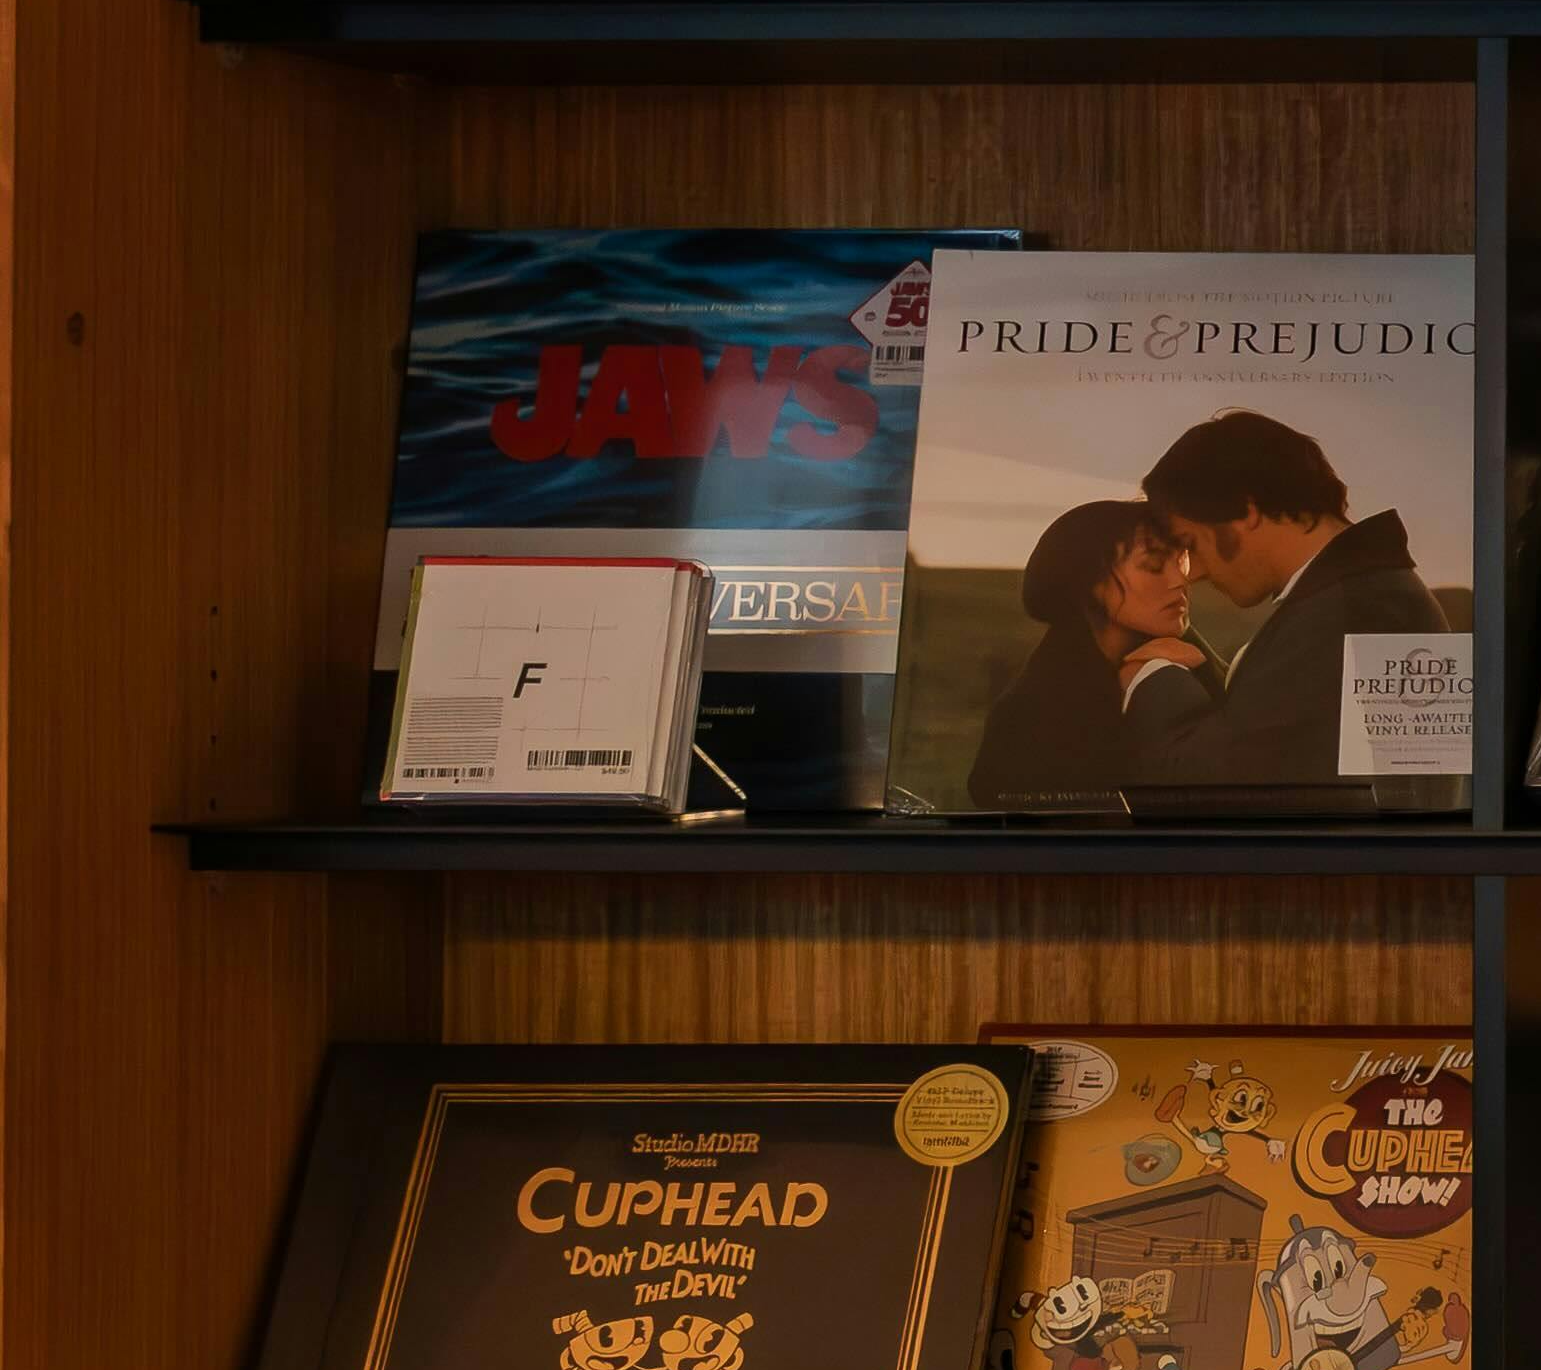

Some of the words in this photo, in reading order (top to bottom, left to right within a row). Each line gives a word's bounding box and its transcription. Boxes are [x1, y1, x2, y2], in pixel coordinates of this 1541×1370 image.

[956, 319, 1134, 356] PRIDE
[1143, 314, 1190, 361] &
[1194, 320, 1475, 362] PREJUDIC
[490, 344, 879, 463] JAWS
[516, 1166, 829, 1234] CUPHEAD
